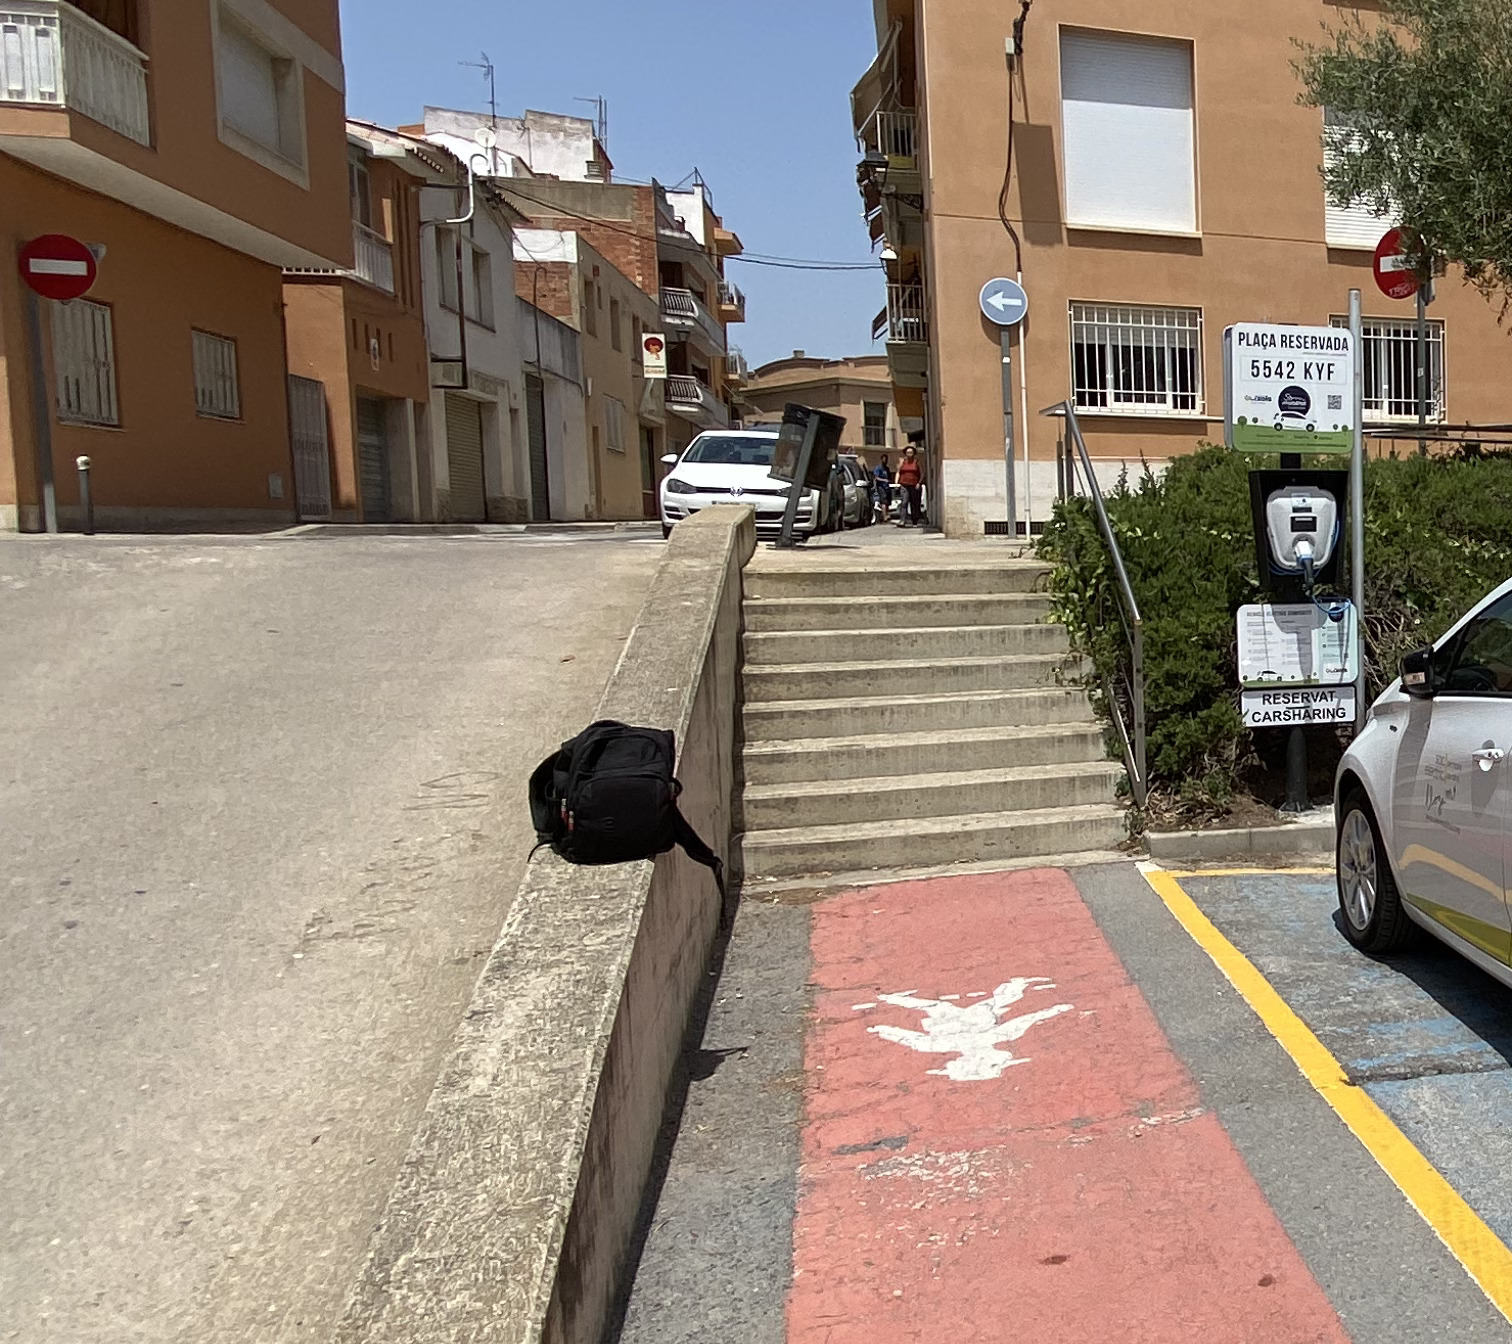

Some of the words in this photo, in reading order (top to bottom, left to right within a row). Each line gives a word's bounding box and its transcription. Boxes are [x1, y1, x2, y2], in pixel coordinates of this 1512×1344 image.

[1238, 331, 1277, 350] PLAÇA
[1280, 333, 1349, 351] RESERVADA
[1251, 359, 1295, 380] 5542
[1303, 361, 1335, 381] KYF
[1262, 690, 1336, 706] RESERVAT
[1251, 707, 1347, 723] CARSHARING
